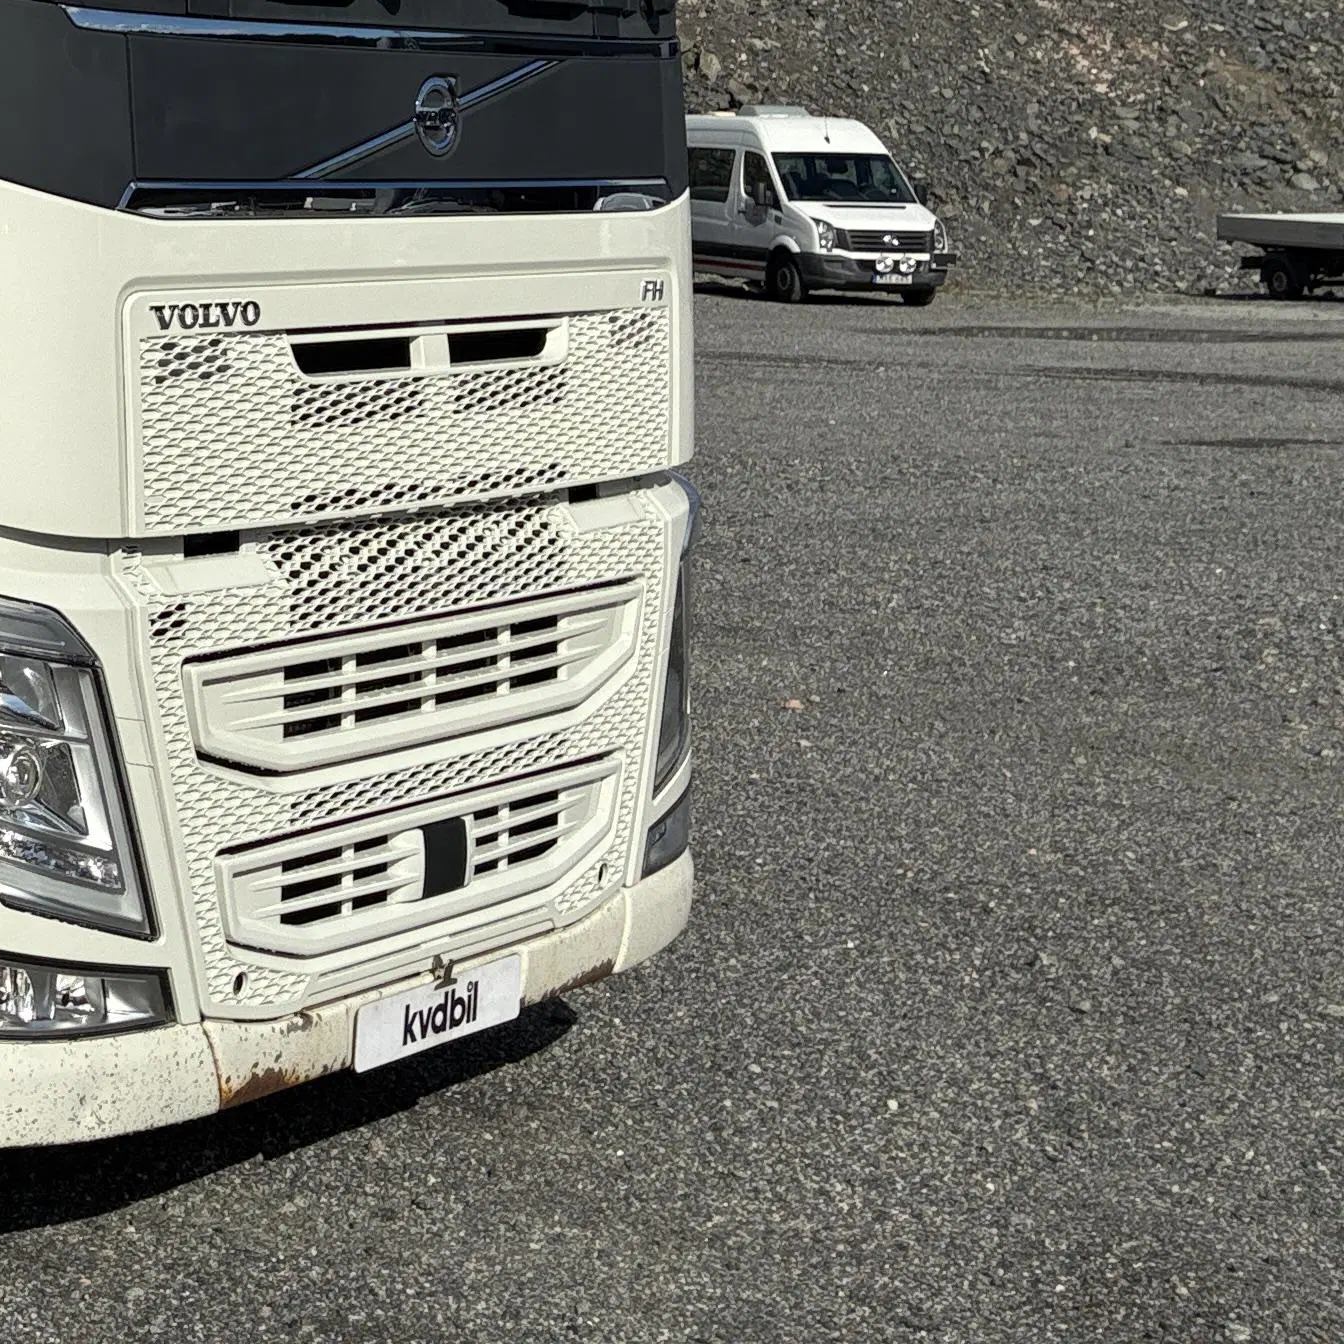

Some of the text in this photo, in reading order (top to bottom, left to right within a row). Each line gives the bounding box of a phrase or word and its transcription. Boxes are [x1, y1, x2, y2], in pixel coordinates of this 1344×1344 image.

[641, 279, 665, 302] FH
[149, 301, 261, 330] VOLVO
[403, 981, 479, 1046] kvdbil
